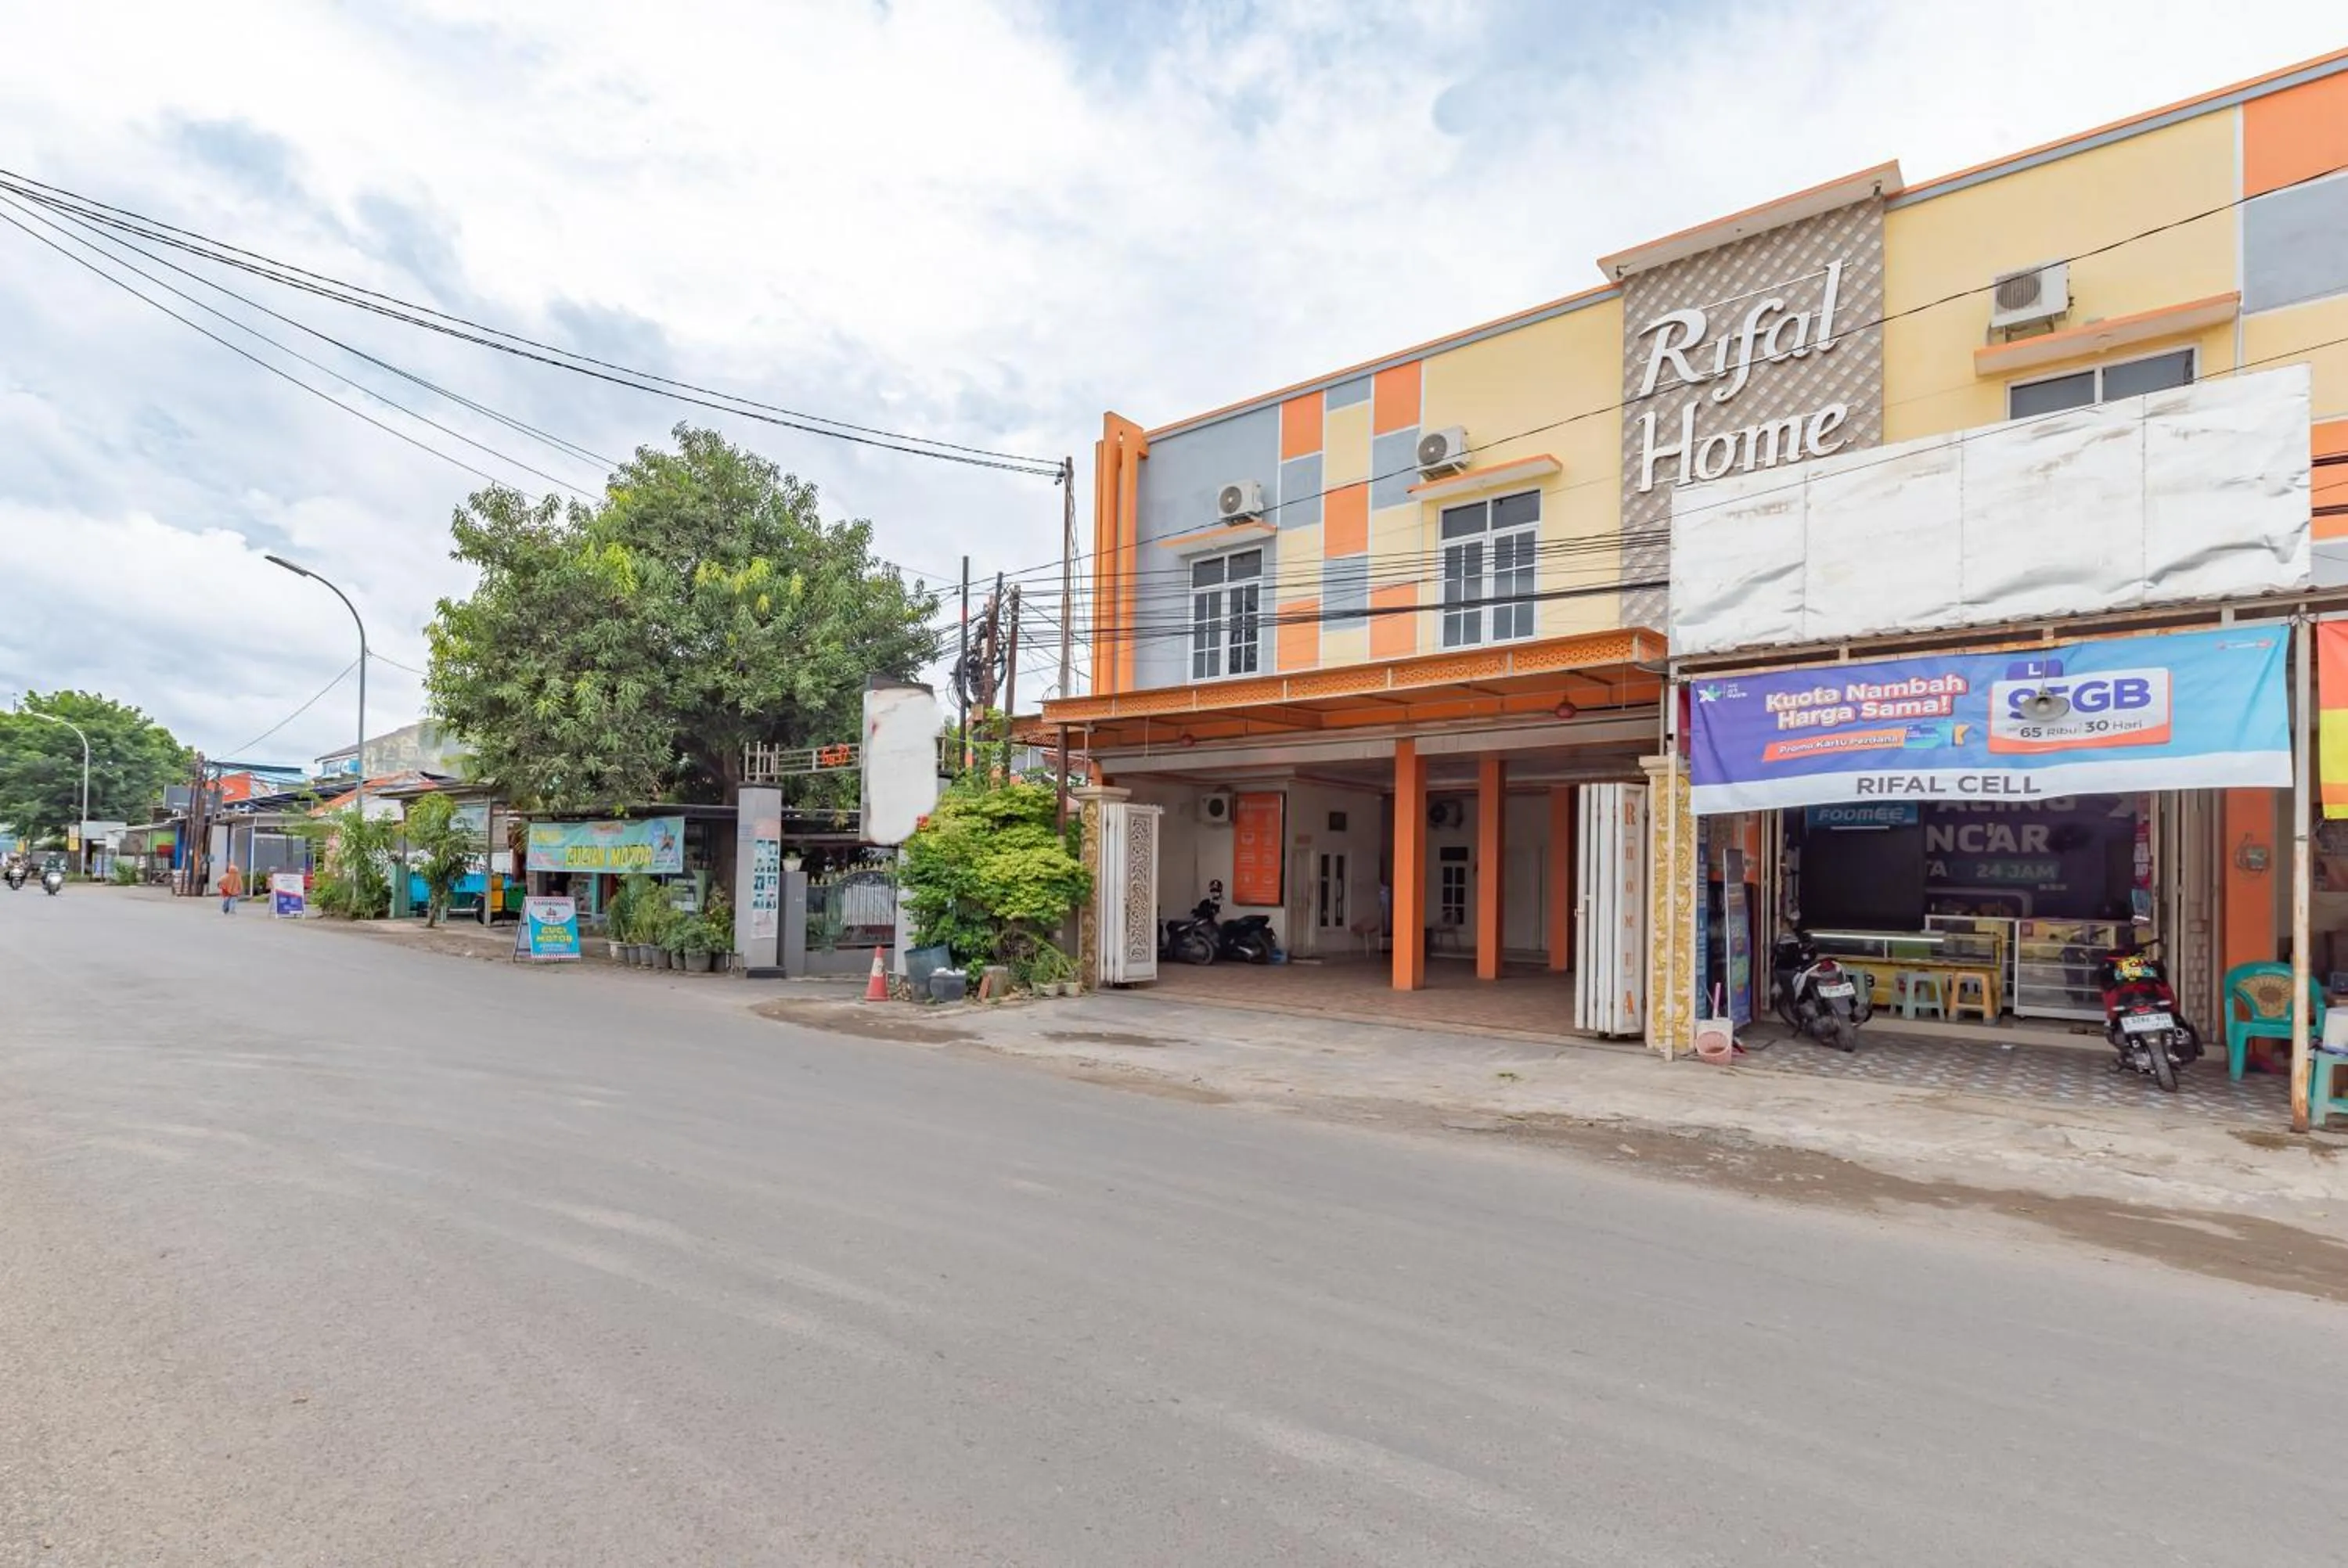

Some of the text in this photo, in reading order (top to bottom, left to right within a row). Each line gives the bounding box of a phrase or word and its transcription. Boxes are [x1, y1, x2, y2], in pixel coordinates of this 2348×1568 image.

[1638, 258, 1845, 403] Rifal
[1637, 401, 1849, 493] Home
[1766, 674, 1967, 713] Kuota Nambah
[2008, 678, 2152, 719] 9GB
[1777, 696, 1952, 729] Harga Sama!
[2020, 726, 2042, 738] 65
[2084, 720, 2109, 733] 30
[2113, 719, 2143, 730] Hari
[1856, 774, 2041, 794] RIFAL CELL
[1976, 862, 2001, 878] 24
[2008, 864, 2056, 879] JAM
